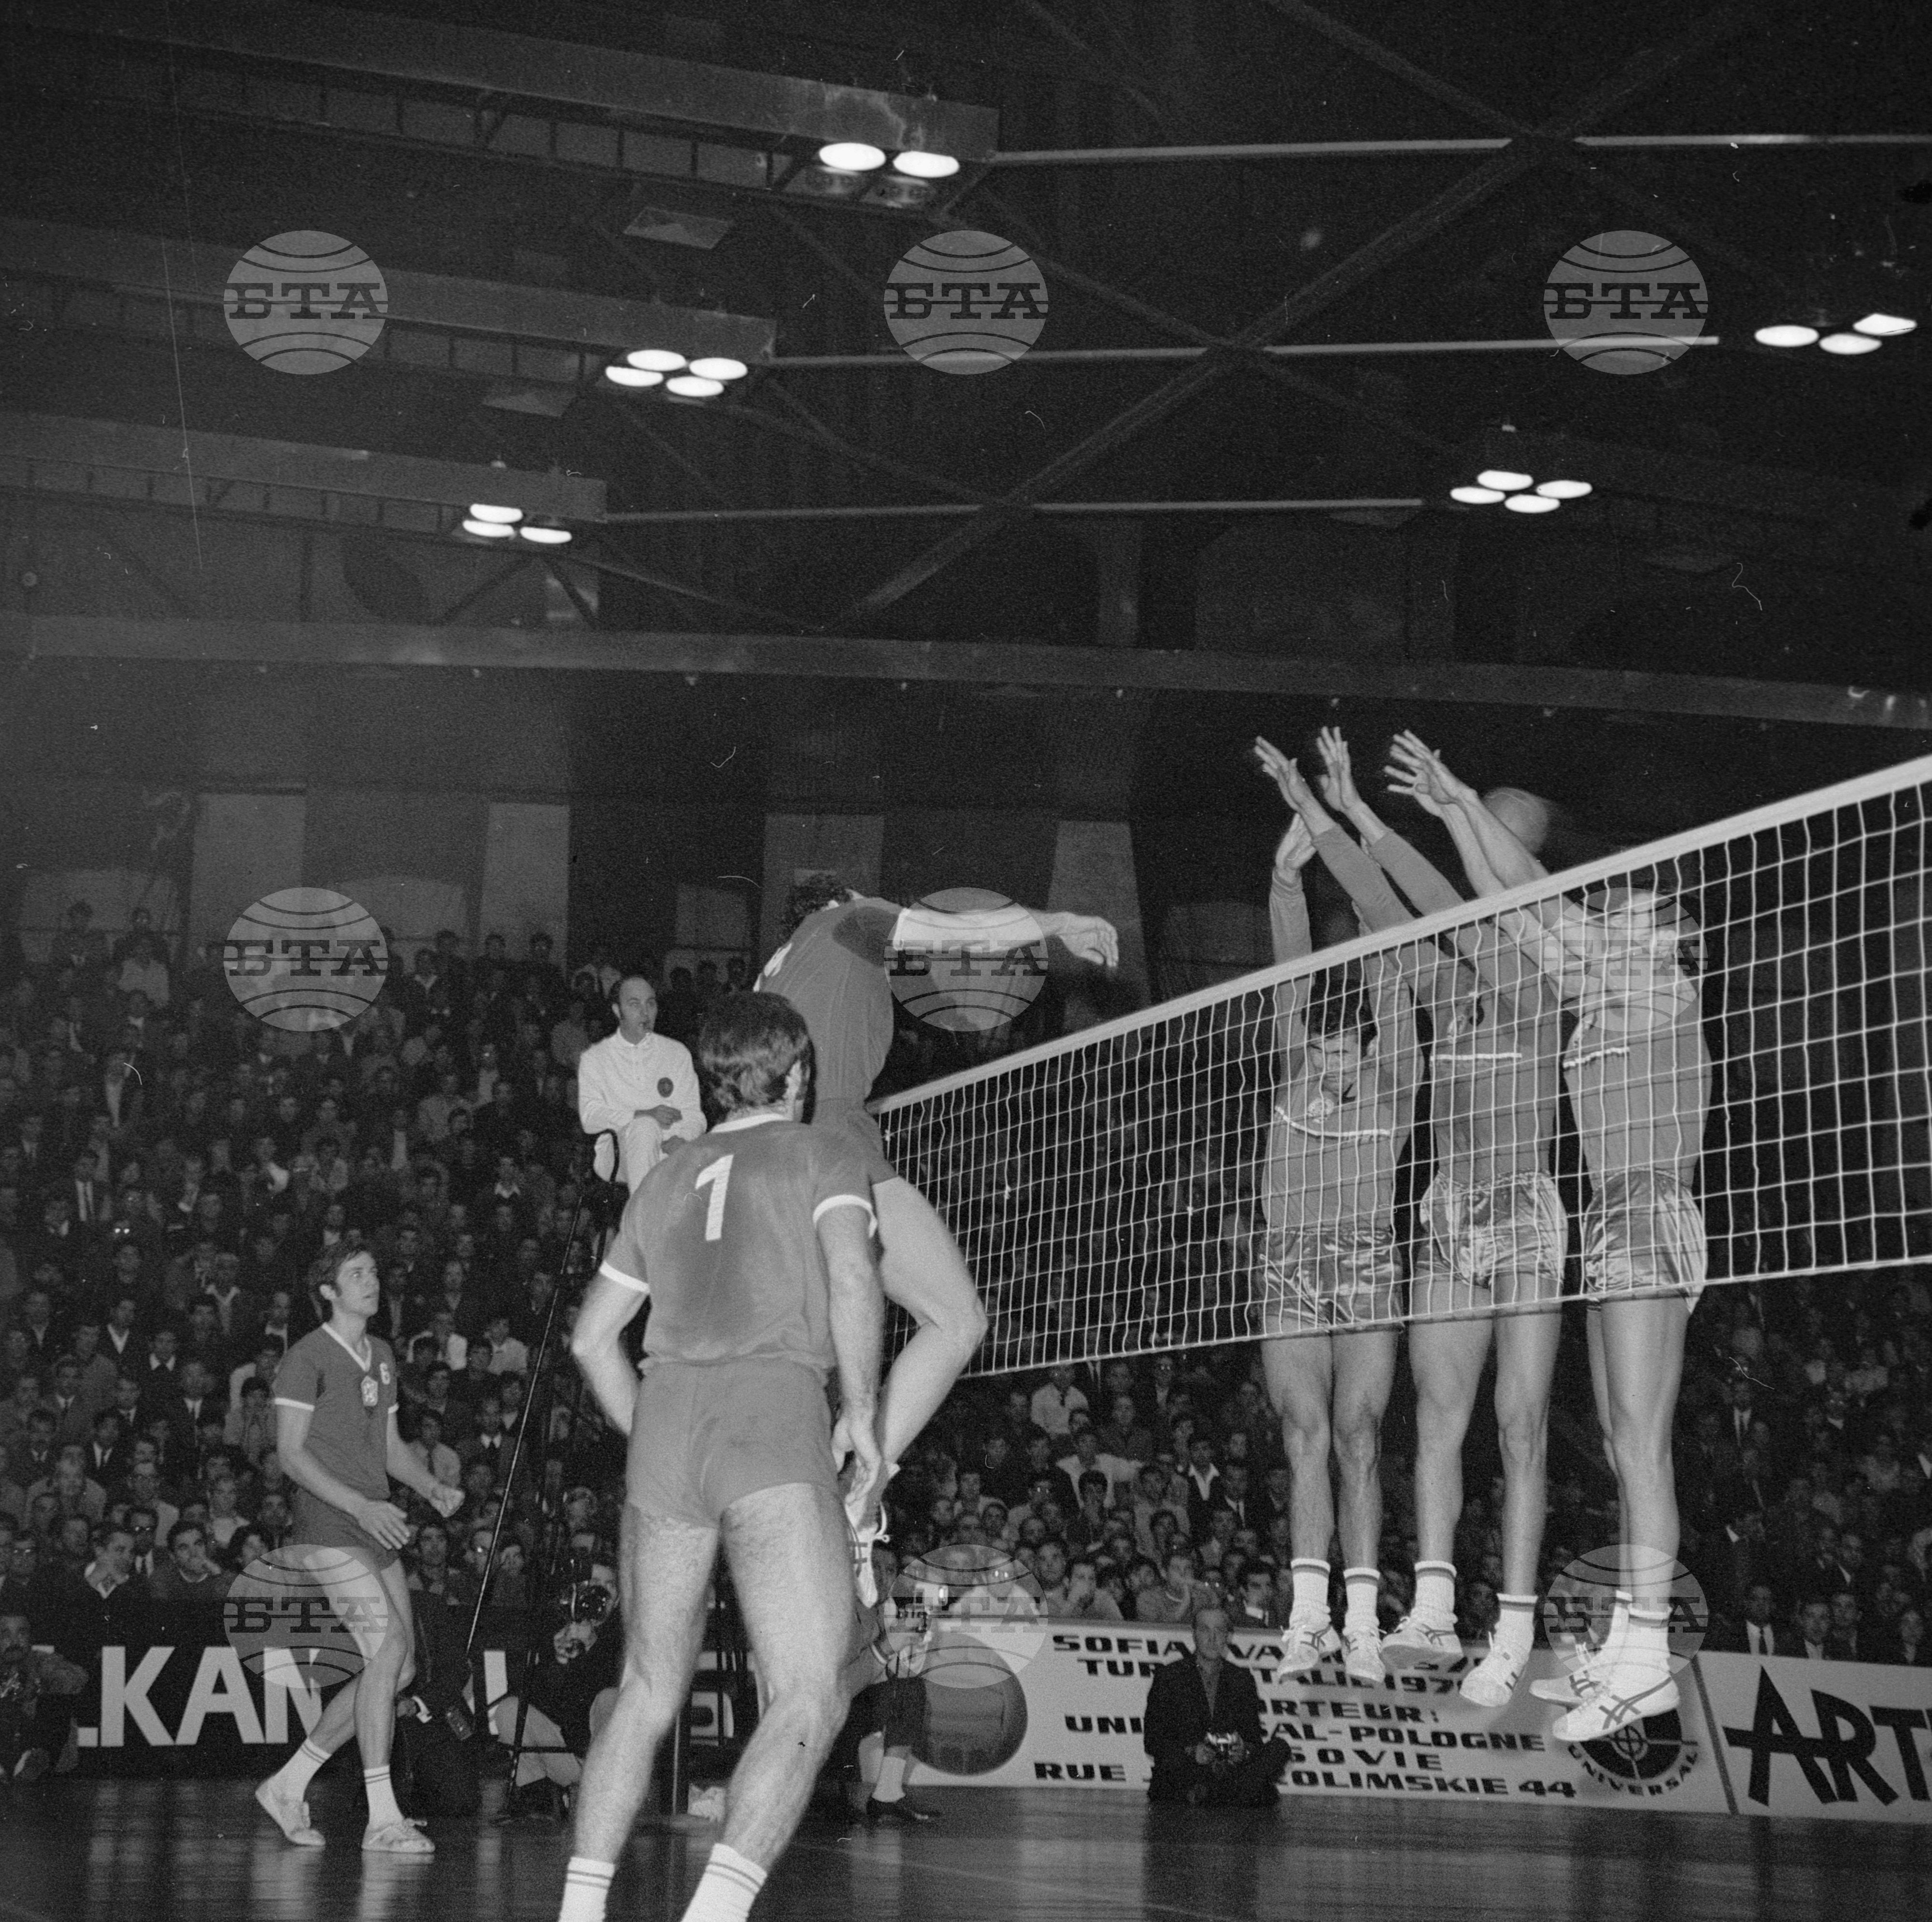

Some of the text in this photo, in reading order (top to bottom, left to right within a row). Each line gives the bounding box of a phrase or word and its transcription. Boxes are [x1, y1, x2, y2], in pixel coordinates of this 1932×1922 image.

[695, 1154, 734, 1241] 1
[1053, 1635, 1184, 1656] SOFIA
[1078, 1658, 1160, 1677] TUR
[1384, 1673, 1463, 1693] 197
[78, 1646, 323, 1747] KAN
[1065, 1716, 1142, 1733] UNI
[1722, 1665, 1932, 1807] ART
[1034, 1763, 1577, 1797] RUE OLIMSKIE 44
